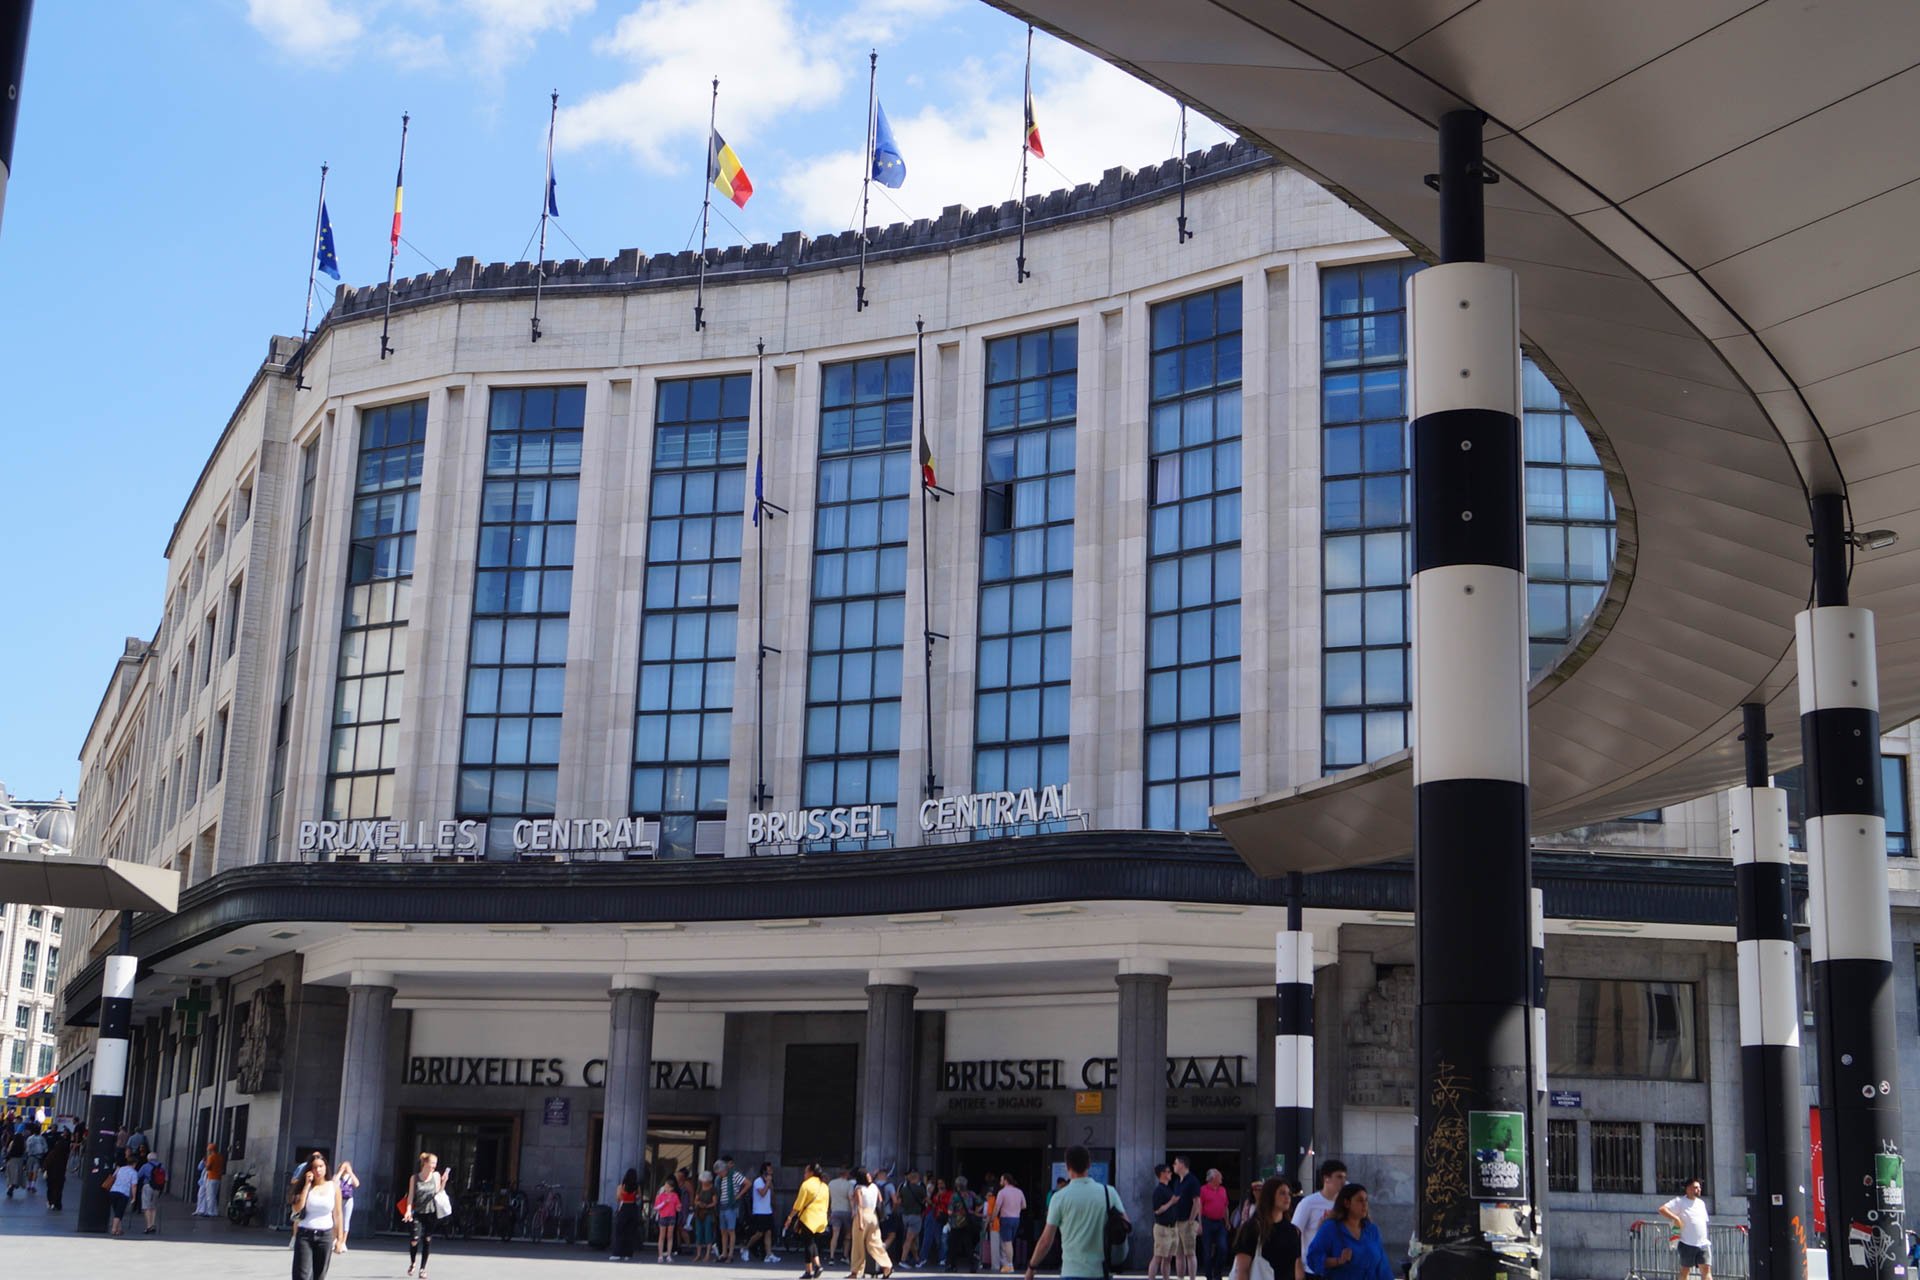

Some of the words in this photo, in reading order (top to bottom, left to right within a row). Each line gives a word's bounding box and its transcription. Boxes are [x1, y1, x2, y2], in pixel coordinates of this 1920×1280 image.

[747, 804, 890, 845] BRUSSEL
[918, 782, 1081, 832] CENTRAAL
[299, 819, 478, 850] BRUXELLES
[513, 817, 656, 850] CENTRAL
[410, 1056, 564, 1087] BRUXELLES
[583, 1058, 716, 1090] CRAL
[945, 1059, 1067, 1091] BRUSSEL
[1081, 1054, 1257, 1090] CERAAL
[998, 1095, 1043, 1110] INGANG
[1191, 1095, 1241, 1109] INGANG
[1082, 1126, 1095, 1145] 2
